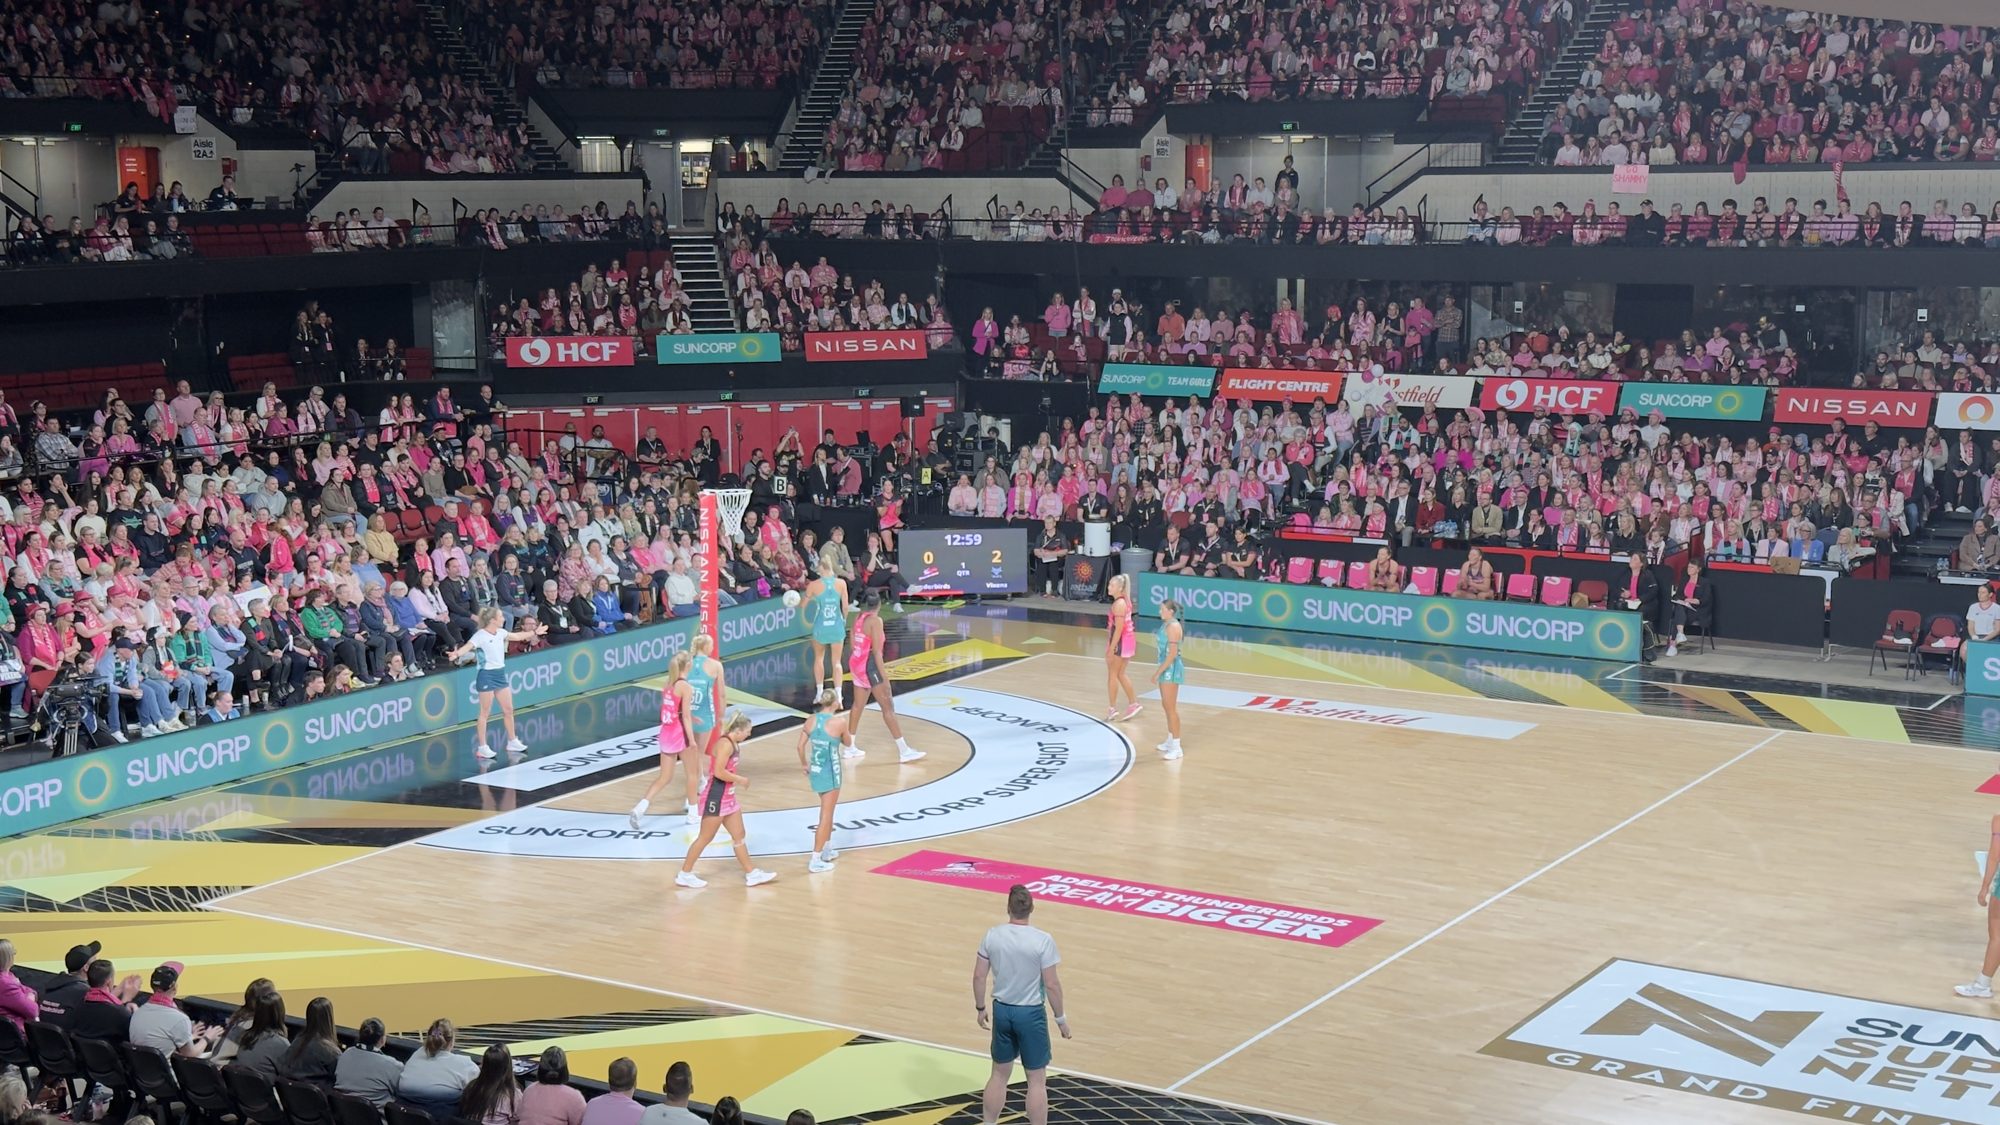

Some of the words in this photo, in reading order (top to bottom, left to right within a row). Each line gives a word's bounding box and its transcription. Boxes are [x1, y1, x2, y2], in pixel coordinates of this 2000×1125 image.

[193, 139, 214, 148] Aisle
[193, 150, 209, 159] 12A
[556, 342, 620, 362] HCF
[672, 342, 737, 355] SUNCORP
[815, 337, 917, 354] NISSAN
[1102, 373, 1147, 385] SUNCORP
[1167, 376, 1190, 386] TEAM
[1188, 377, 1213, 388] GIRLS
[1228, 379, 1276, 391] FLIGHT
[1276, 380, 1331, 394] CENTRE
[1534, 385, 1603, 410] HCF
[1639, 392, 1713, 408] SUNCORP
[1787, 398, 1918, 417] NISSAN
[776, 479, 785, 492] B
[699, 507, 709, 583] NISSAN
[944, 533, 983, 546] 12:59
[923, 551, 934, 565] 0
[991, 550, 1002, 563] 2
[1150, 584, 1253, 613] SUNCORP
[721, 608, 797, 642] SUNCORP
[823, 606, 837, 619] GK
[1303, 598, 1413, 628] SUNCORP
[1466, 612, 1585, 643] SUNCORP
[603, 632, 686, 671] SUNCORP
[304, 697, 413, 744] SUNCORP
[951, 704, 1069, 733] SUNCORP
[1238, 695, 1431, 727] Westfield
[126, 734, 251, 787] SUNCORP
[538, 733, 661, 773] SUNCOR
[982, 767, 1061, 798] SUPER
[1035, 741, 1070, 766] SHOT
[0, 778, 63, 817] ORP
[708, 801, 717, 813] 5
[478, 825, 671, 841] SUNCORP
[1024, 880, 1137, 910] DREAM
[1136, 898, 1336, 941] BIGGER
[1040, 874, 1159, 902] ADELAIDE
[1161, 891, 1354, 929] THUNDERBIRDS
[1546, 1051, 1769, 1101] GRAND
[1801, 1097, 1955, 1125] FIN
[1800, 1054, 2000, 1108] NET
